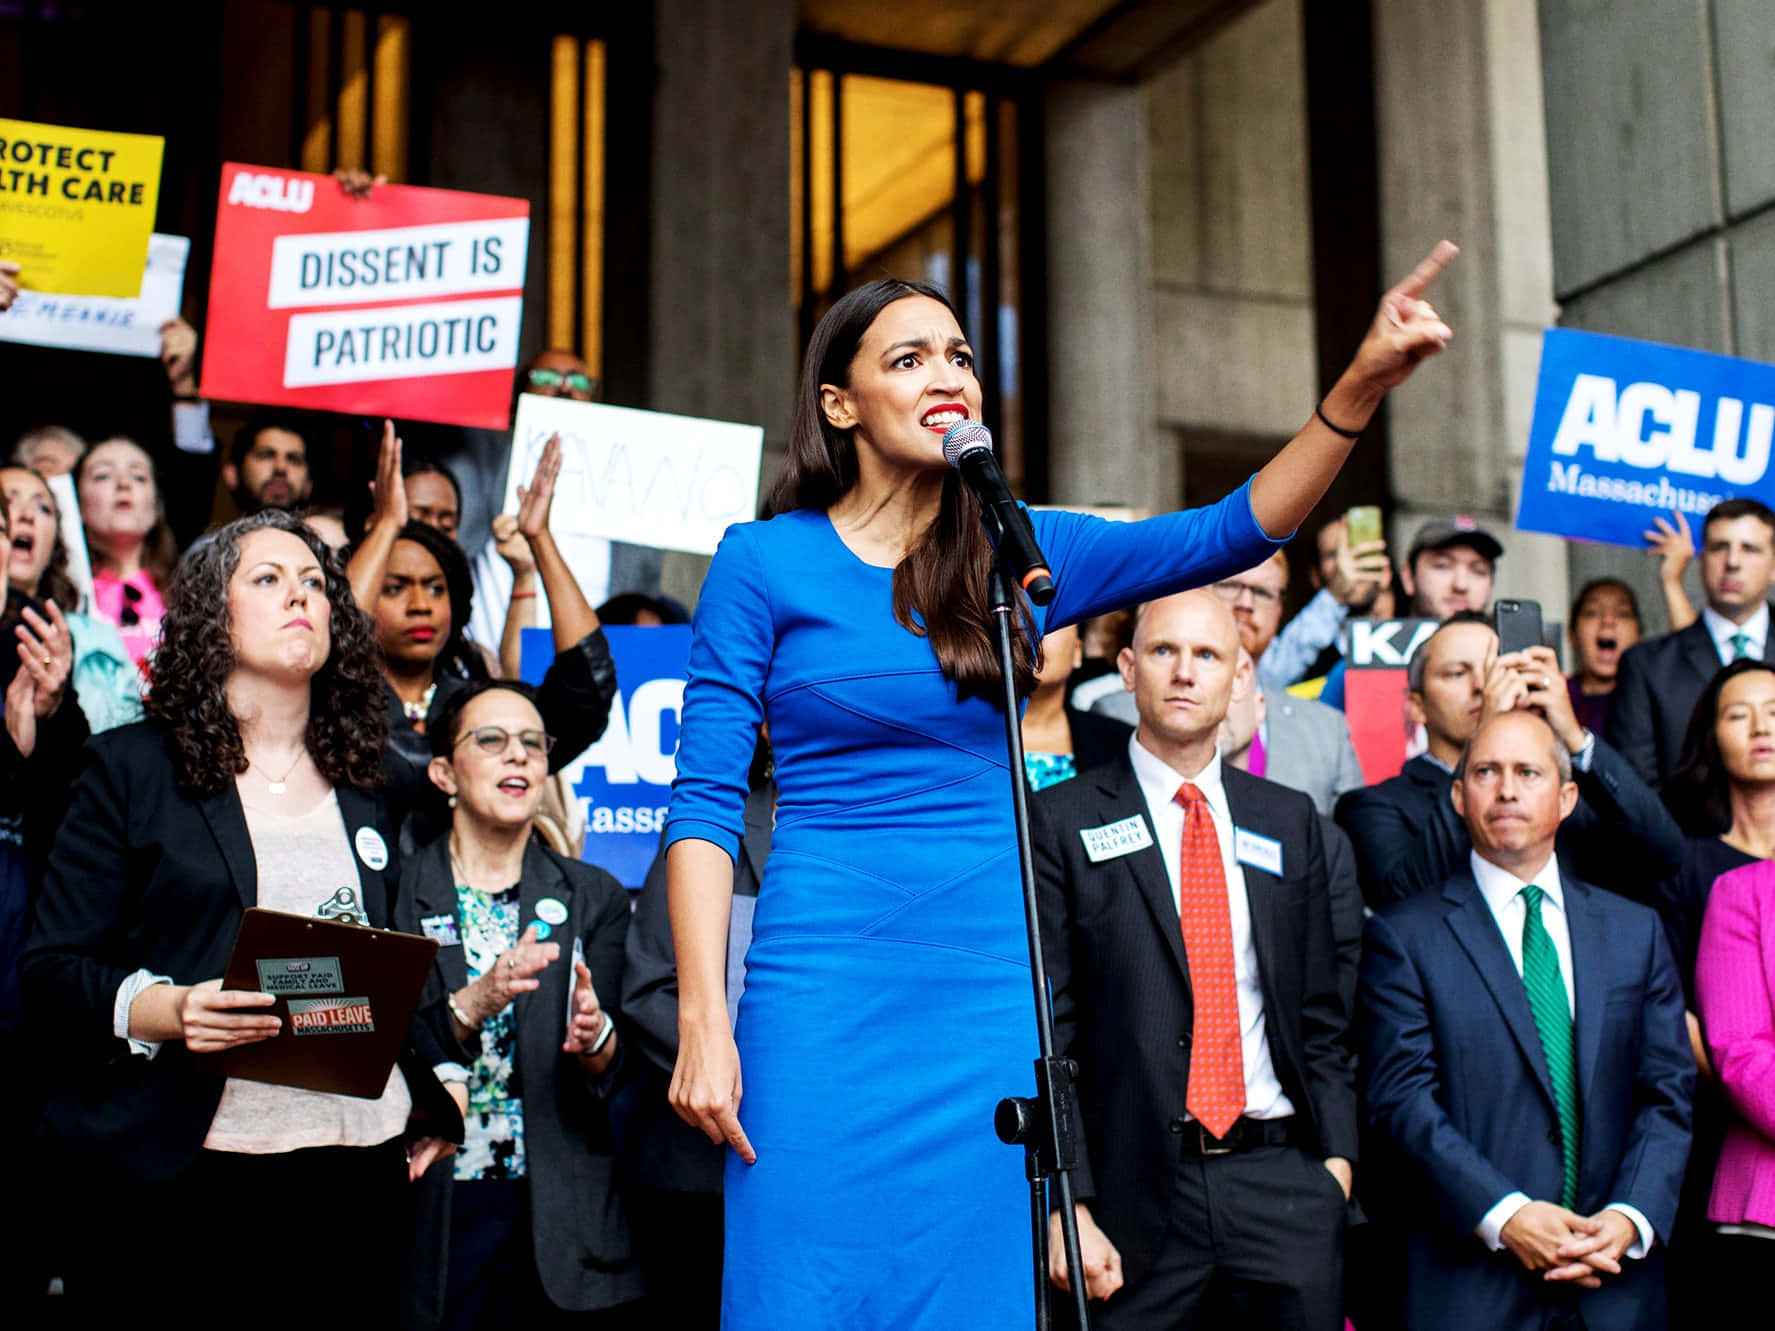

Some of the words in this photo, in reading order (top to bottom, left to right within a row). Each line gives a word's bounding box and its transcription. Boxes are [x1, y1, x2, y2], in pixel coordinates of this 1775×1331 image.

[61, 177, 144, 205] CARE
[229, 173, 313, 212] ACLU
[300, 241, 450, 290] DISSENT
[471, 236, 502, 275] IS
[313, 315, 497, 368] PATRIOTIC
[1551, 373, 1775, 486] ACLU
[1547, 461, 1722, 516] Massachus
[294, 1012, 327, 1027] PAID
[331, 1005, 373, 1025] LEAVE
[297, 1024, 370, 1034] MASSACHUSETTS
